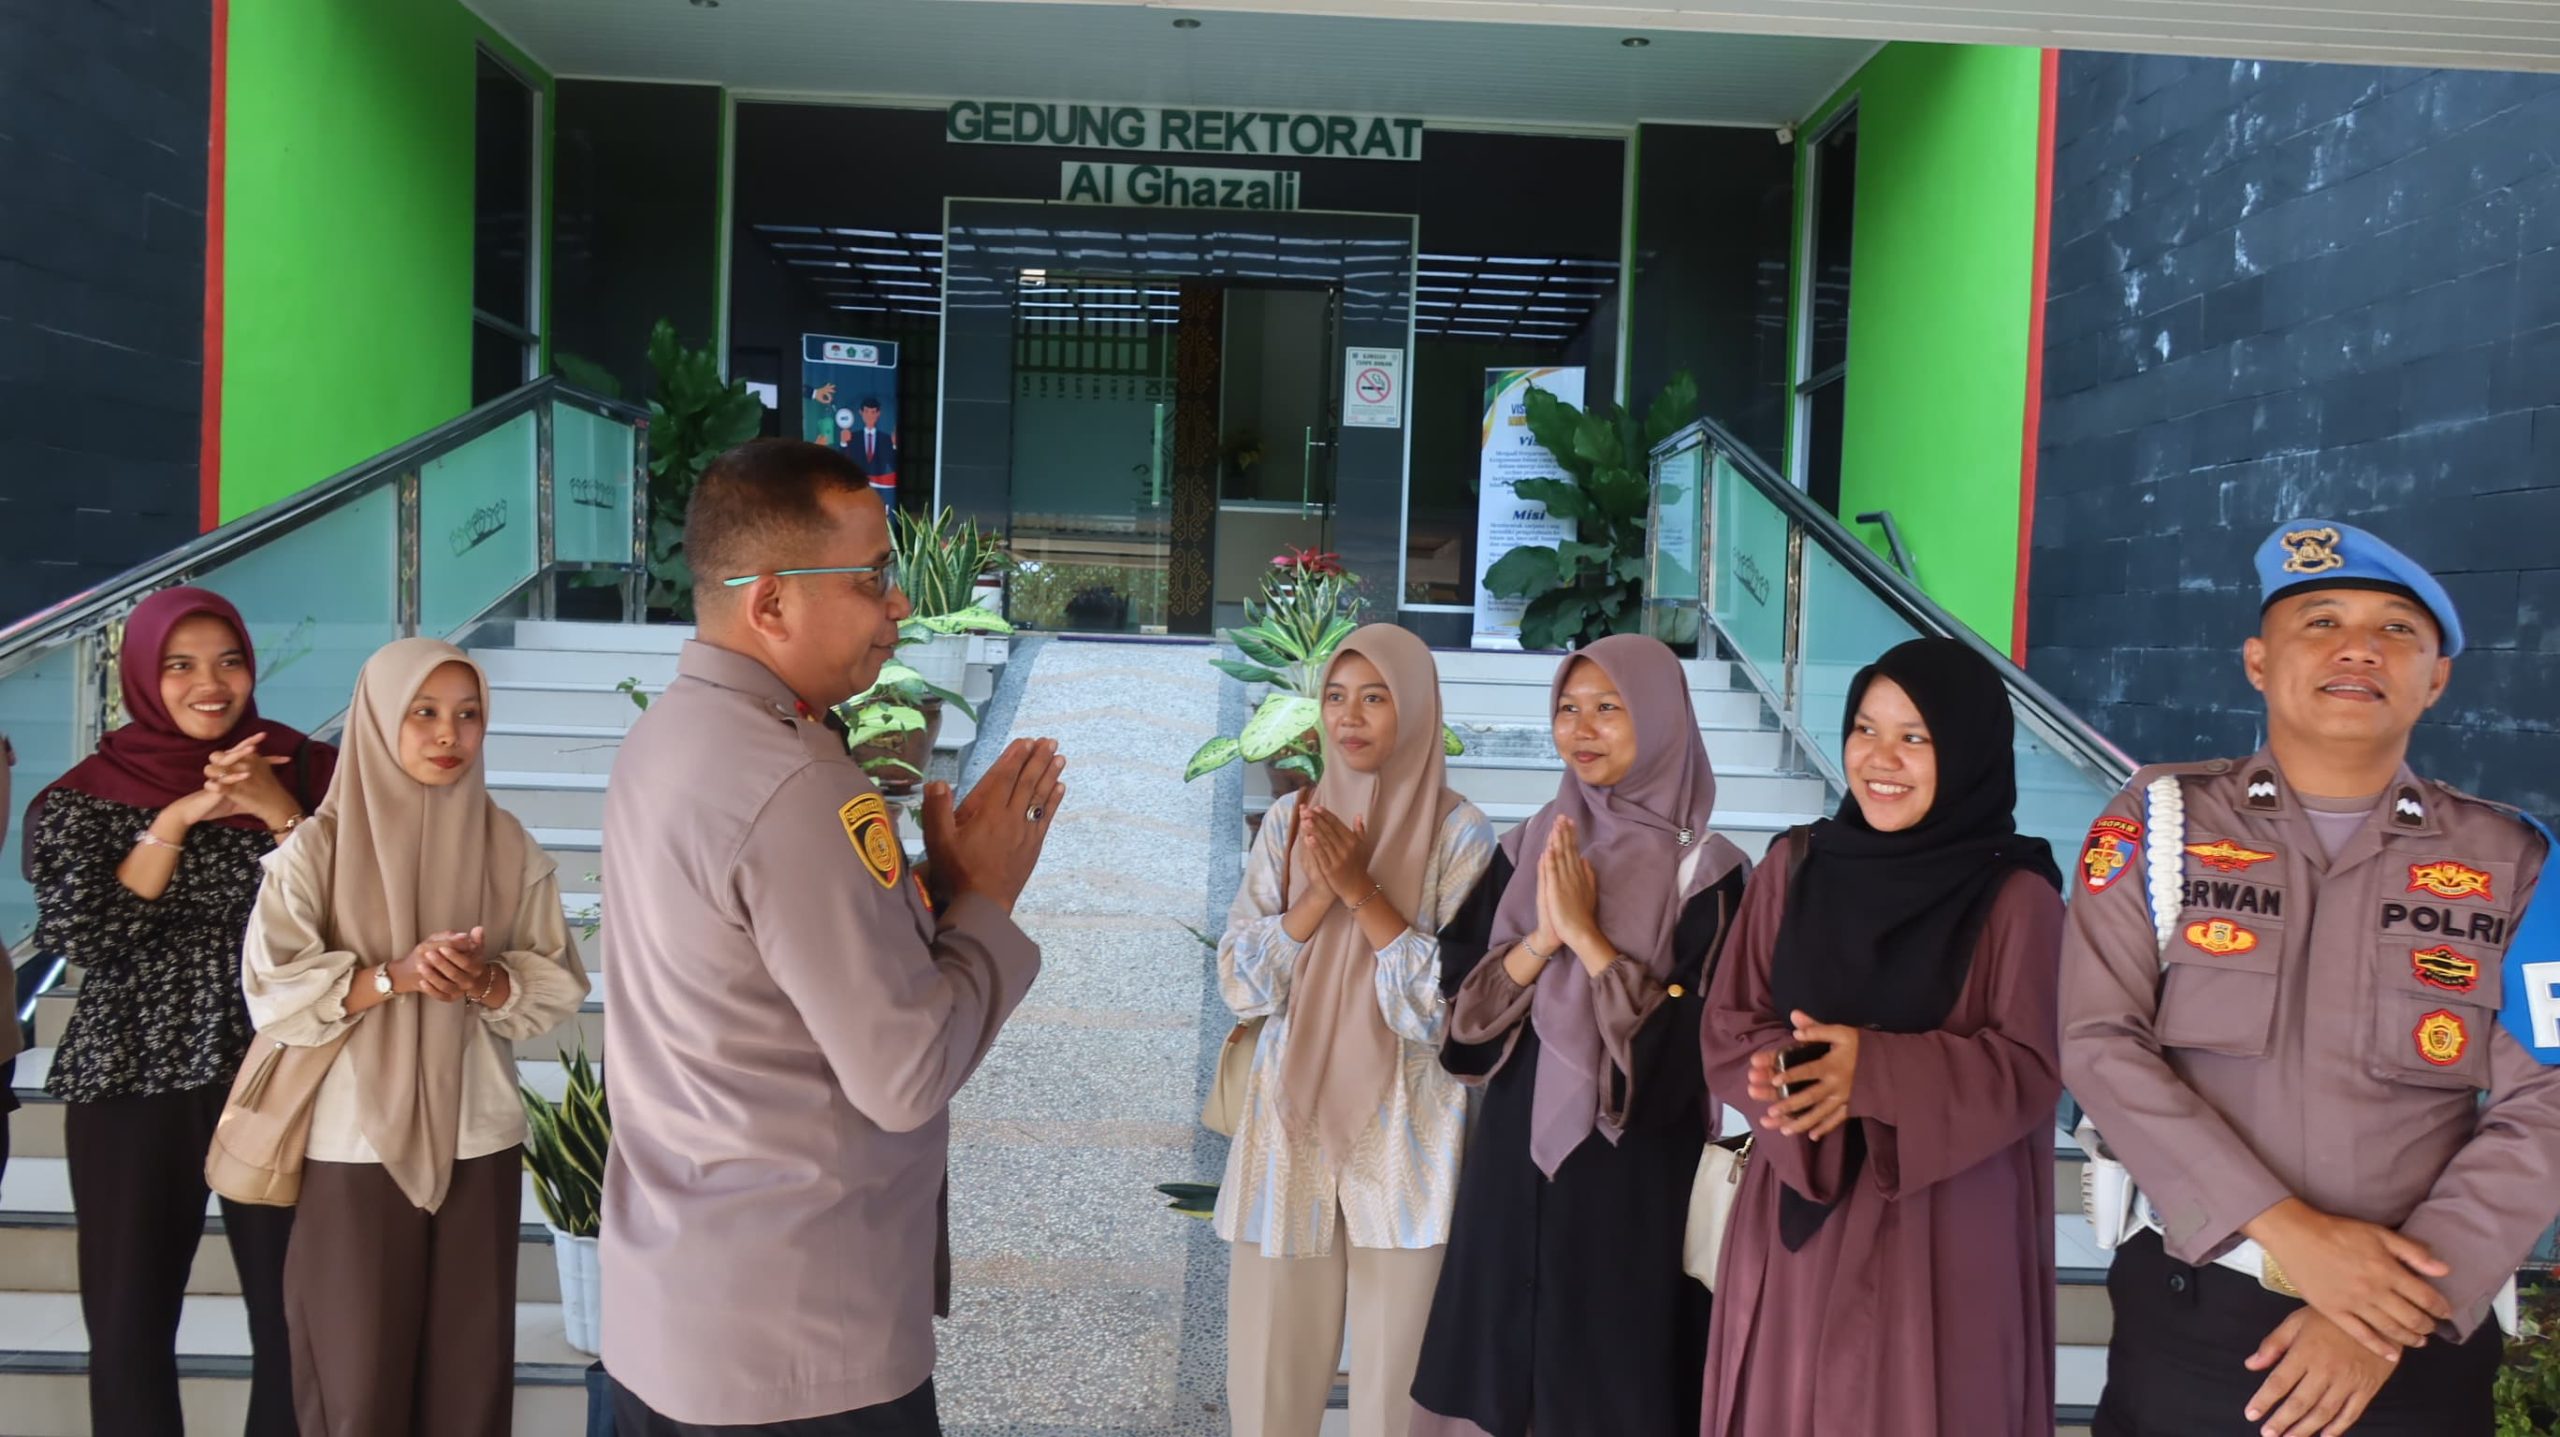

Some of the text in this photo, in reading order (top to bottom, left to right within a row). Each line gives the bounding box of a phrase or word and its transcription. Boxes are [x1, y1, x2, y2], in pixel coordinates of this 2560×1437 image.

[947, 100, 1424, 159] GEDUNG REKTORAT
[1066, 164, 1295, 211] Al Ghazali
[1512, 509, 1546, 521] Misi
[2381, 903, 2504, 945] POLRI
